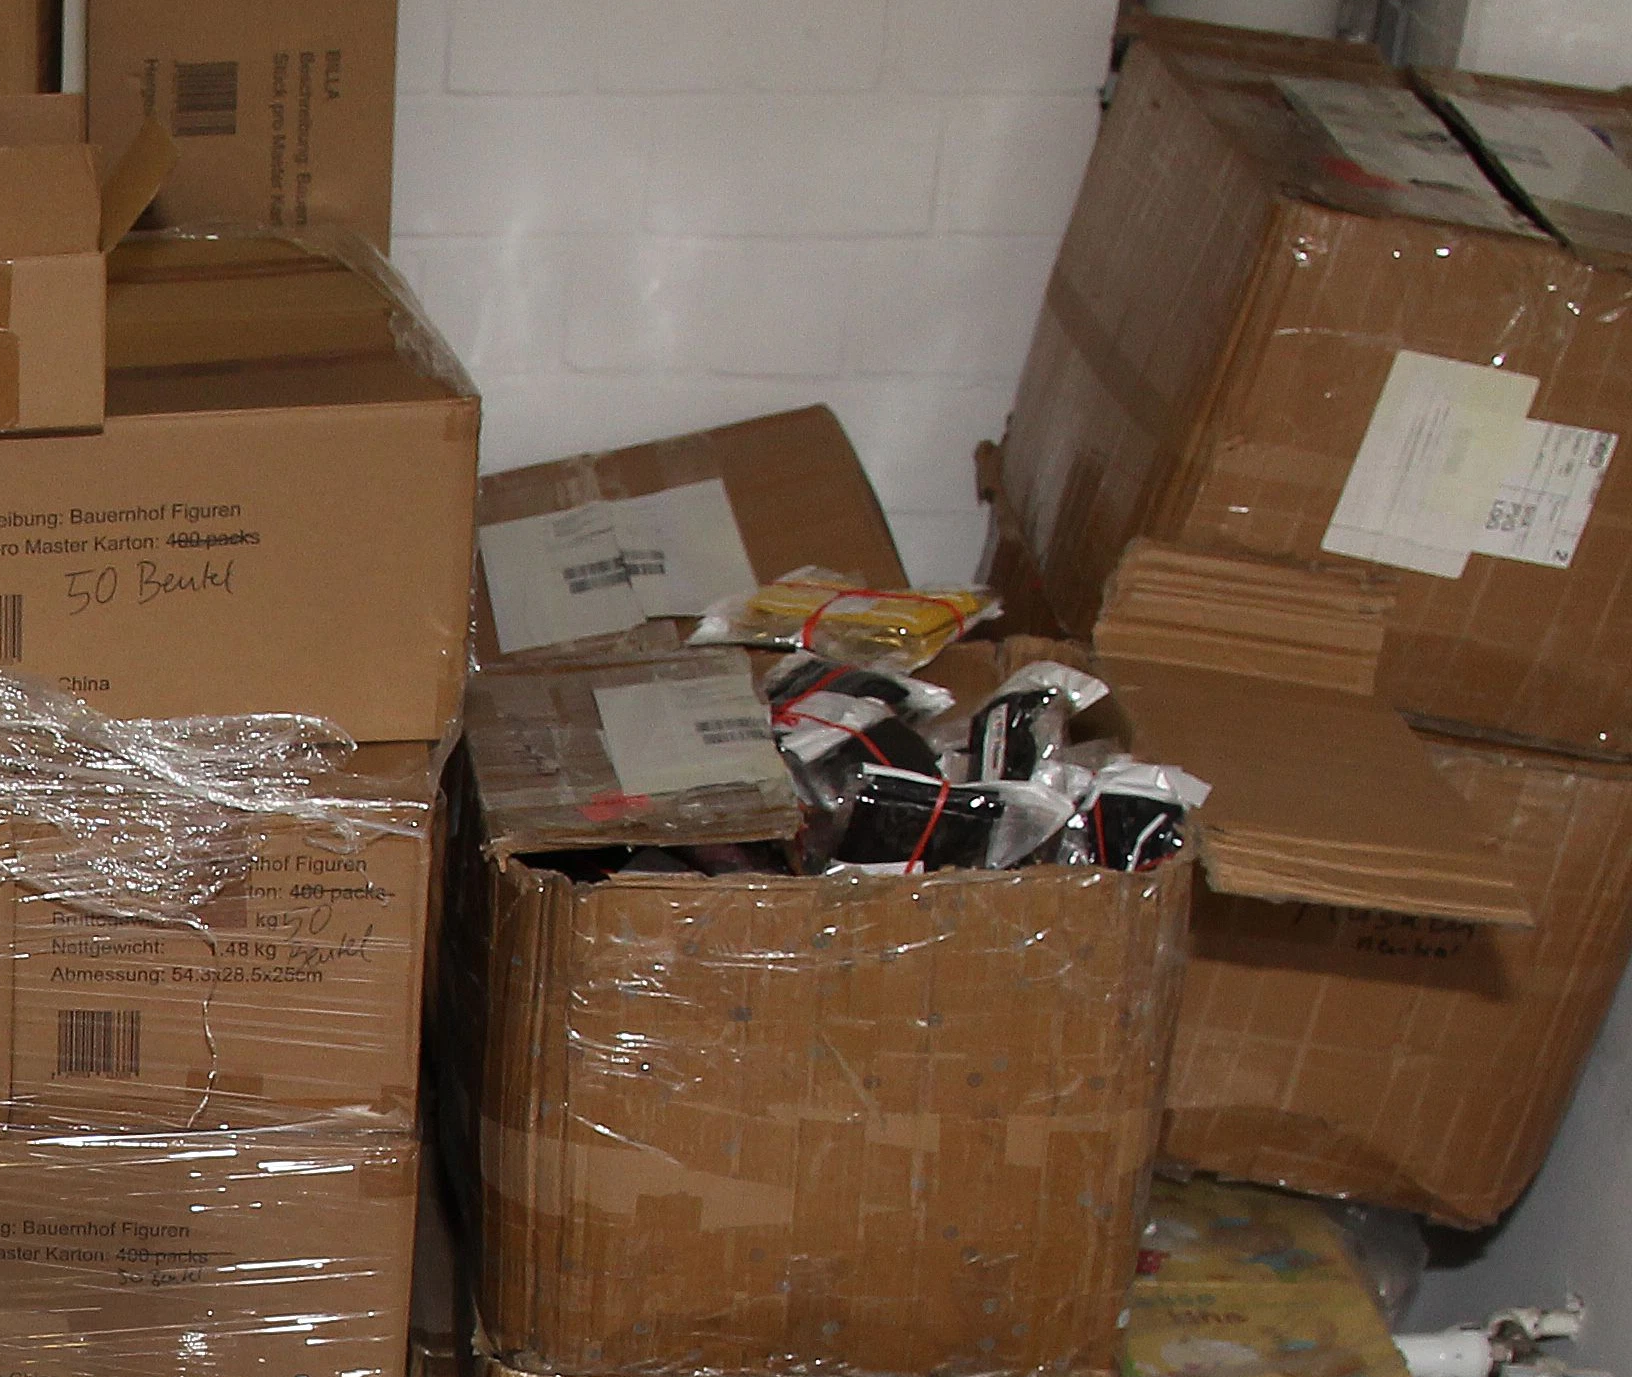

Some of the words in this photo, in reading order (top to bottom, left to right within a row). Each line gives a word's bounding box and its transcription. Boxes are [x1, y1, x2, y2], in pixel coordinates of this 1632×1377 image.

[69, 502, 167, 525] Bauernhof
[171, 500, 242, 523] Figuren
[24, 535, 88, 557] Master
[92, 532, 160, 553] Karton:
[205, 527, 261, 551] packs
[64, 565, 118, 615] 50
[295, 855, 367, 875] Figuren
[255, 912, 279, 931] kg
[51, 938, 166, 958] Nettgewicht:
[208, 939, 249, 957] 1.48
[252, 940, 277, 961] kg
[50, 965, 167, 987] Abmessung:
[22, 1218, 116, 1238] Bauernhof
[120, 1220, 191, 1241] Figuren
